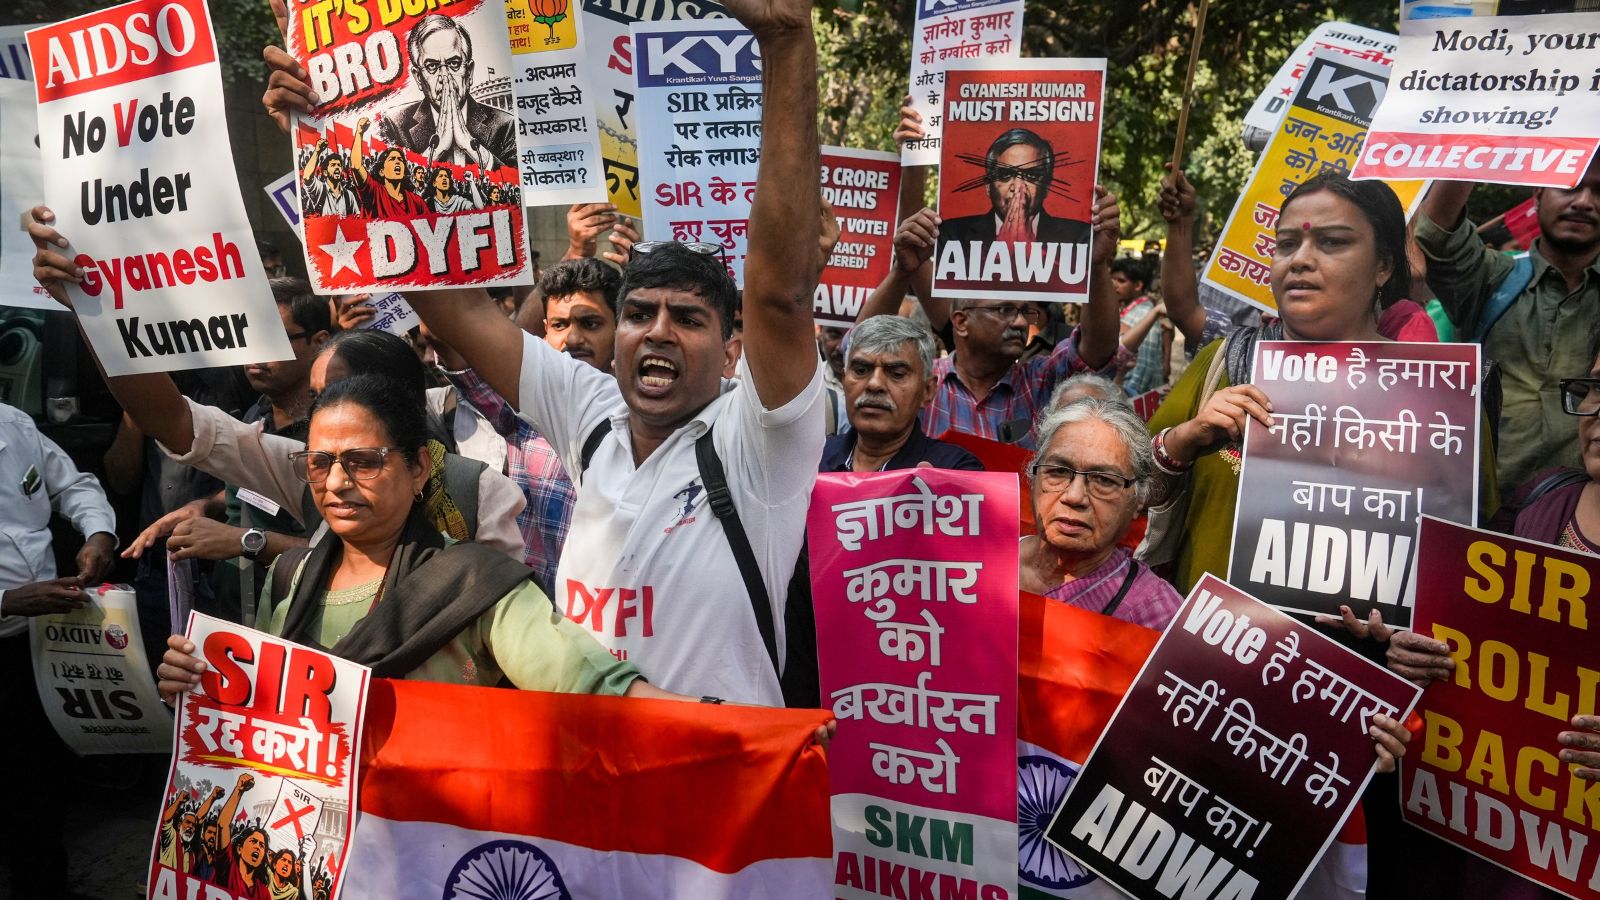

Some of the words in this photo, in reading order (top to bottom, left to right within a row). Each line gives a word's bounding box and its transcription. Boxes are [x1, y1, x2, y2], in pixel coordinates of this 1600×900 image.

[923, 16, 966, 44] ज्ञानेश
[970, 11, 1014, 40] कुमार
[1432, 29, 1514, 56] Modi,
[1523, 31, 1600, 56] your
[45, 2, 196, 89] AIDSO
[920, 46, 936, 65] को
[985, 34, 1012, 55] करो
[308, 30, 400, 106] BRO
[666, 75, 706, 83] Krantikari
[915, 70, 935, 86] और
[1399, 69, 1579, 97] dictatorship
[1590, 72, 1600, 92] i
[517, 93, 550, 115] वजूद
[549, 85, 582, 106] कैसे
[667, 92, 710, 113] SIR
[960, 82, 1027, 98] GYANESH
[1031, 82, 1086, 98] KUMAR
[1306, 64, 1388, 119] KY
[62, 111, 106, 159] No
[113, 91, 195, 147] Vote
[528, 116, 587, 136] सरकार!
[948, 101, 1005, 122] MUST
[1010, 101, 1094, 122] RESIGN!
[1316, 104, 1352, 121] Krantikari
[1419, 105, 1558, 130] showing!
[673, 122, 700, 140] पर
[906, 134, 940, 151] कार्यवा
[664, 144, 703, 168] रोक
[1284, 147, 1319, 174] को
[1363, 142, 1585, 174] COLLECTIVE
[523, 164, 587, 186] लोकतंत्र?
[655, 181, 704, 207] SIR
[708, 176, 736, 205] के
[832, 167, 889, 190] CRORE
[80, 168, 191, 226] Under
[821, 187, 877, 210] DIANS
[707, 219, 749, 249] चुन
[847, 217, 889, 236] VOTE!
[366, 209, 515, 279] DYFI
[833, 241, 863, 256] RACY
[864, 244, 876, 257] IS
[73, 233, 245, 310] Gyanesh
[826, 254, 868, 269] DERED!
[936, 240, 1088, 285] AIAWU
[116, 312, 248, 359] Kumar
[1262, 349, 1338, 383] Vote
[1346, 347, 1370, 390] है
[1376, 358, 1478, 397] हमारा,
[1267, 402, 1327, 452] नहीं
[1333, 405, 1421, 454] किसी
[1428, 411, 1466, 456] के
[831, 475, 984, 551] ज्ञानेश
[1292, 480, 1356, 516] बाप
[1362, 487, 1423, 523] का!
[842, 558, 983, 622] कुमार
[1464, 540, 1591, 630] SIR
[565, 578, 654, 638] DYFI
[46, 625, 103, 645] AIDYO
[876, 609, 945, 667] को
[1182, 588, 1267, 665] Vote
[1261, 631, 1301, 686] है
[202, 631, 336, 724] SIR
[55, 687, 143, 721] SIR
[830, 671, 1000, 736] बर्खास्त
[195, 706, 247, 760] रद्द
[250, 717, 339, 777] करो!
[1157, 670, 1226, 732] नहीं
[1210, 697, 1308, 787] किसी
[1304, 751, 1351, 809] के
[869, 738, 960, 795] करो
[293, 788, 311, 805] SIR
[1143, 755, 1210, 818] बाप
[1205, 793, 1273, 858] का!
[864, 804, 974, 866] SKM
[1070, 783, 1261, 900] AIDWA
[1407, 767, 1600, 892] AIDW
